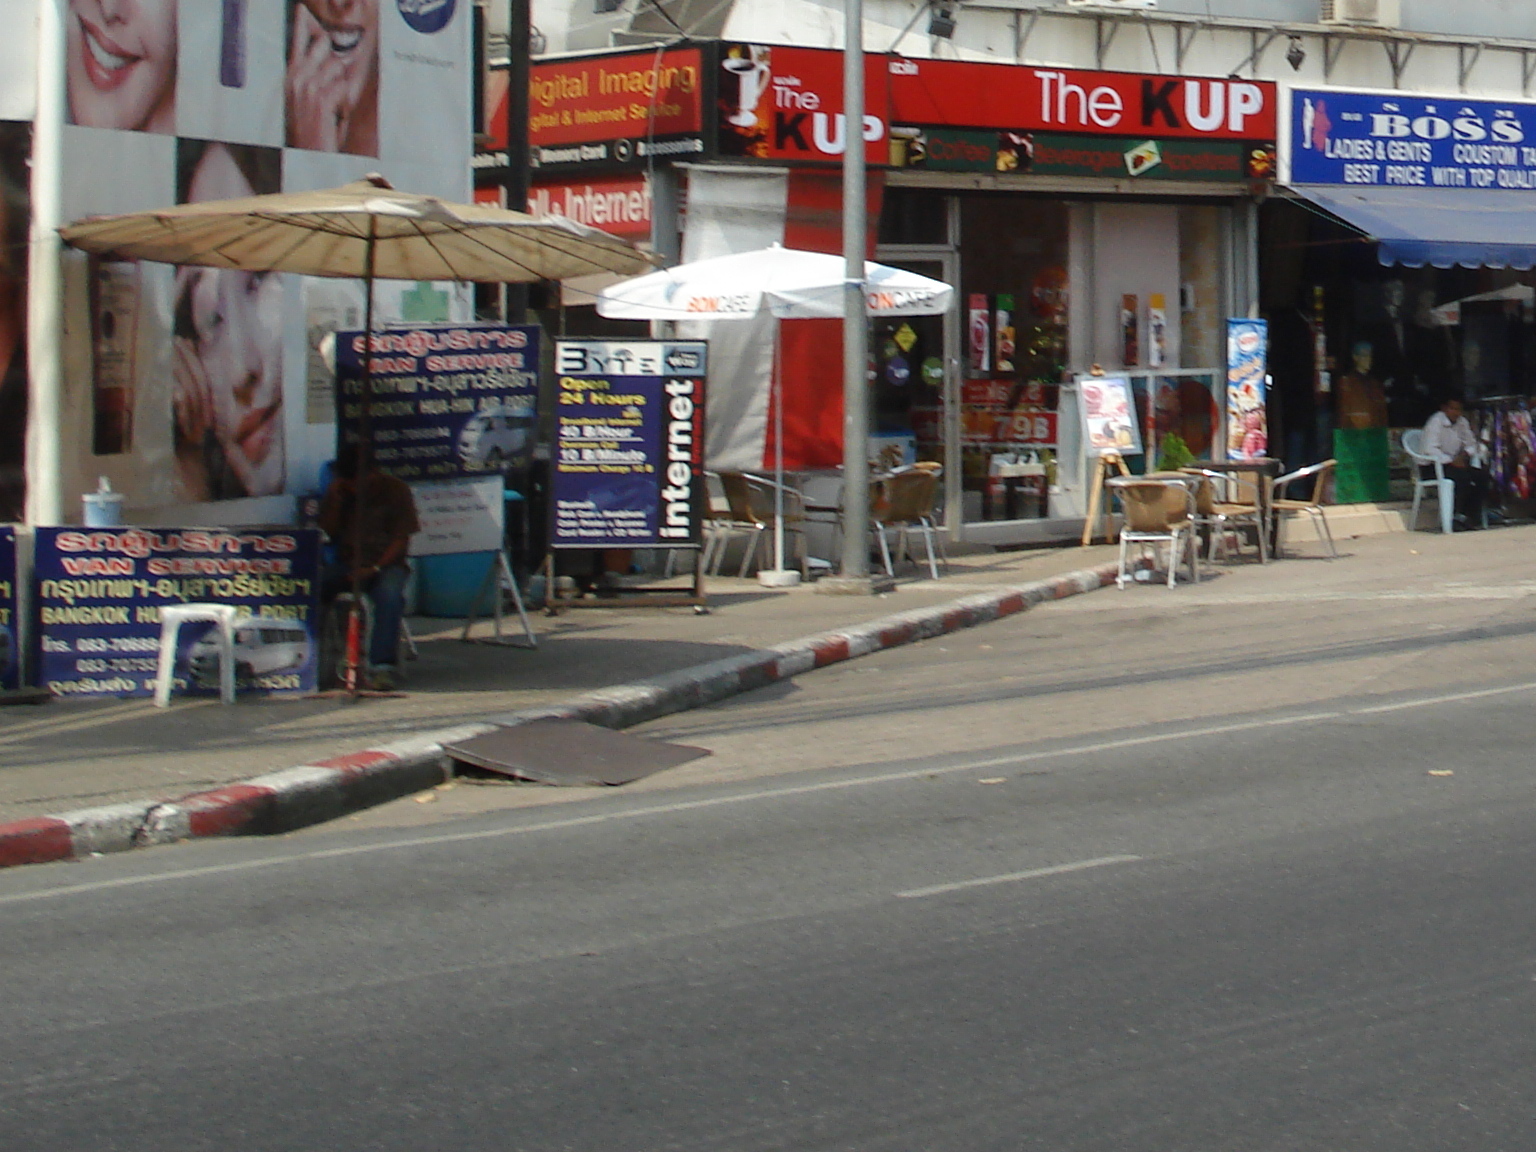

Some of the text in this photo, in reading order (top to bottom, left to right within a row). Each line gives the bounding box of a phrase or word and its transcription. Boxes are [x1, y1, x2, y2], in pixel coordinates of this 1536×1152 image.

[599, 64, 696, 98] Imaging
[772, 85, 820, 110] The
[1034, 70, 1265, 132] The KUP
[774, 112, 885, 155] KUP
[1369, 113, 1525, 144] BOSS
[1326, 138, 1375, 161] LADIES
[1375, 140, 1387, 161] &
[1387, 140, 1433, 164] GENTS
[1344, 163, 1380, 185] BEST
[1385, 165, 1426, 186] PRICE
[1431, 166, 1467, 187] WITH
[1468, 167, 1496, 188] TOP
[564, 173, 652, 225] Internet
[867, 290, 935, 311] ONCAFE
[560, 377, 610, 391] Open
[589, 391, 647, 405] Hours
[659, 379, 694, 538] internet
[61, 557, 292, 576] VAN SERVICE
[41, 605, 131, 625] BANGKOK
